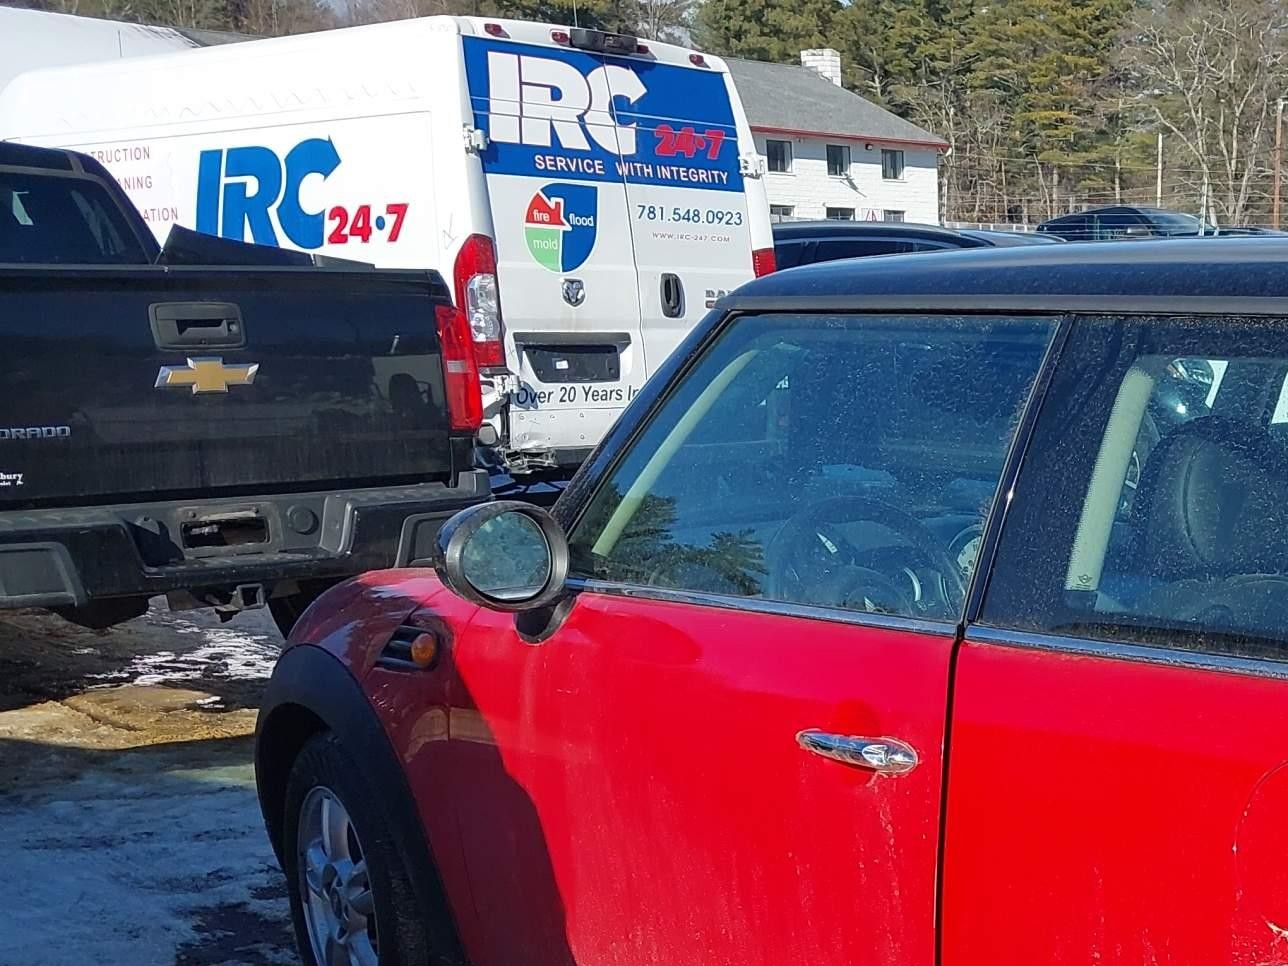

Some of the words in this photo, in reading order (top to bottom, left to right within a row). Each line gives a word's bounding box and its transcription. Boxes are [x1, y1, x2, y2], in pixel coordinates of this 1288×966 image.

[487, 51, 648, 155] IRC
[86, 146, 150, 164] TRUCTION
[534, 155, 605, 174] SERVICE
[616, 161, 653, 178] WITH
[656, 163, 728, 185] INTEGRITY
[196, 134, 342, 249] IRC
[533, 210, 550, 222] fire
[569, 213, 594, 227] flood
[637, 205, 743, 226] 781.548.0923
[533, 238, 558, 250] mold
[516, 387, 554, 404] Over
[559, 386, 577, 403] 20
[582, 384, 623, 402] Years
